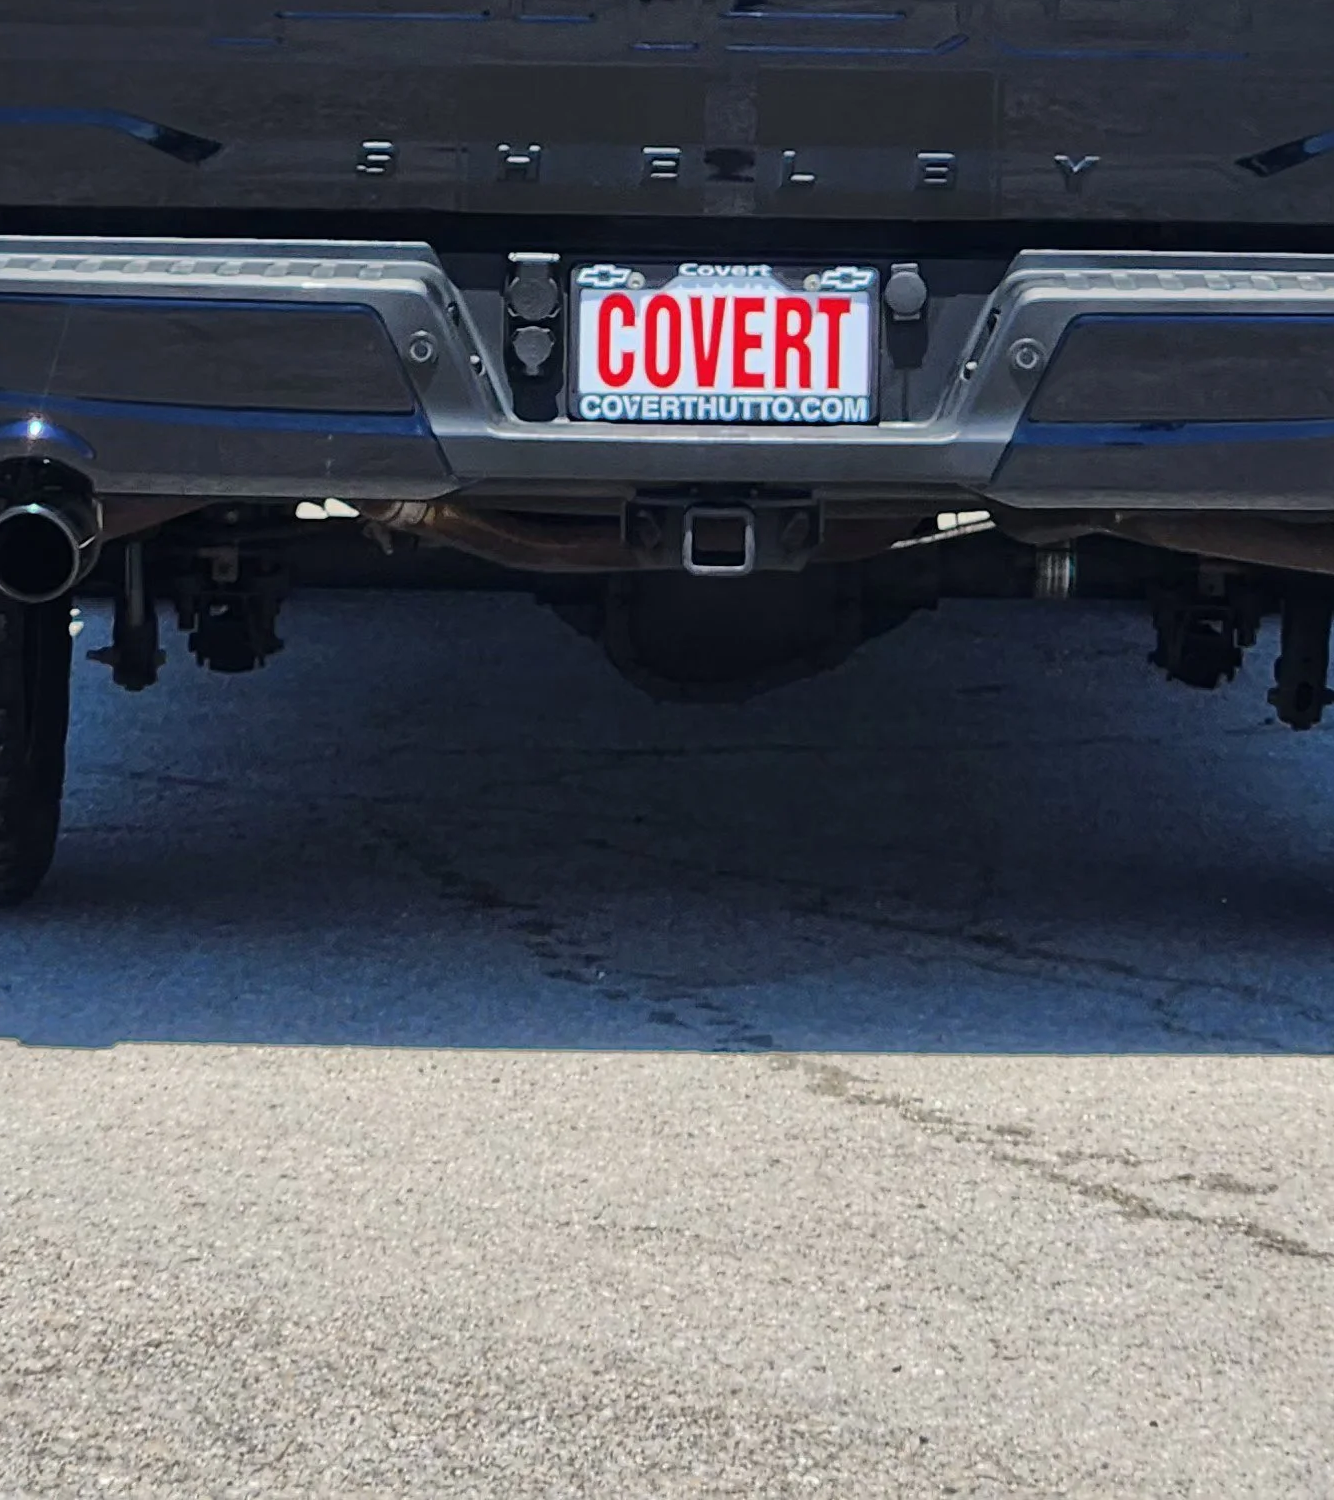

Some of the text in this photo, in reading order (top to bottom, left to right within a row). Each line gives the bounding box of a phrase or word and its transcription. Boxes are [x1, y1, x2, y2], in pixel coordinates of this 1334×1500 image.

[678, 263, 773, 277] Covert
[597, 292, 852, 390] COVERT
[579, 395, 868, 422] COVERTHUTTO.COM
